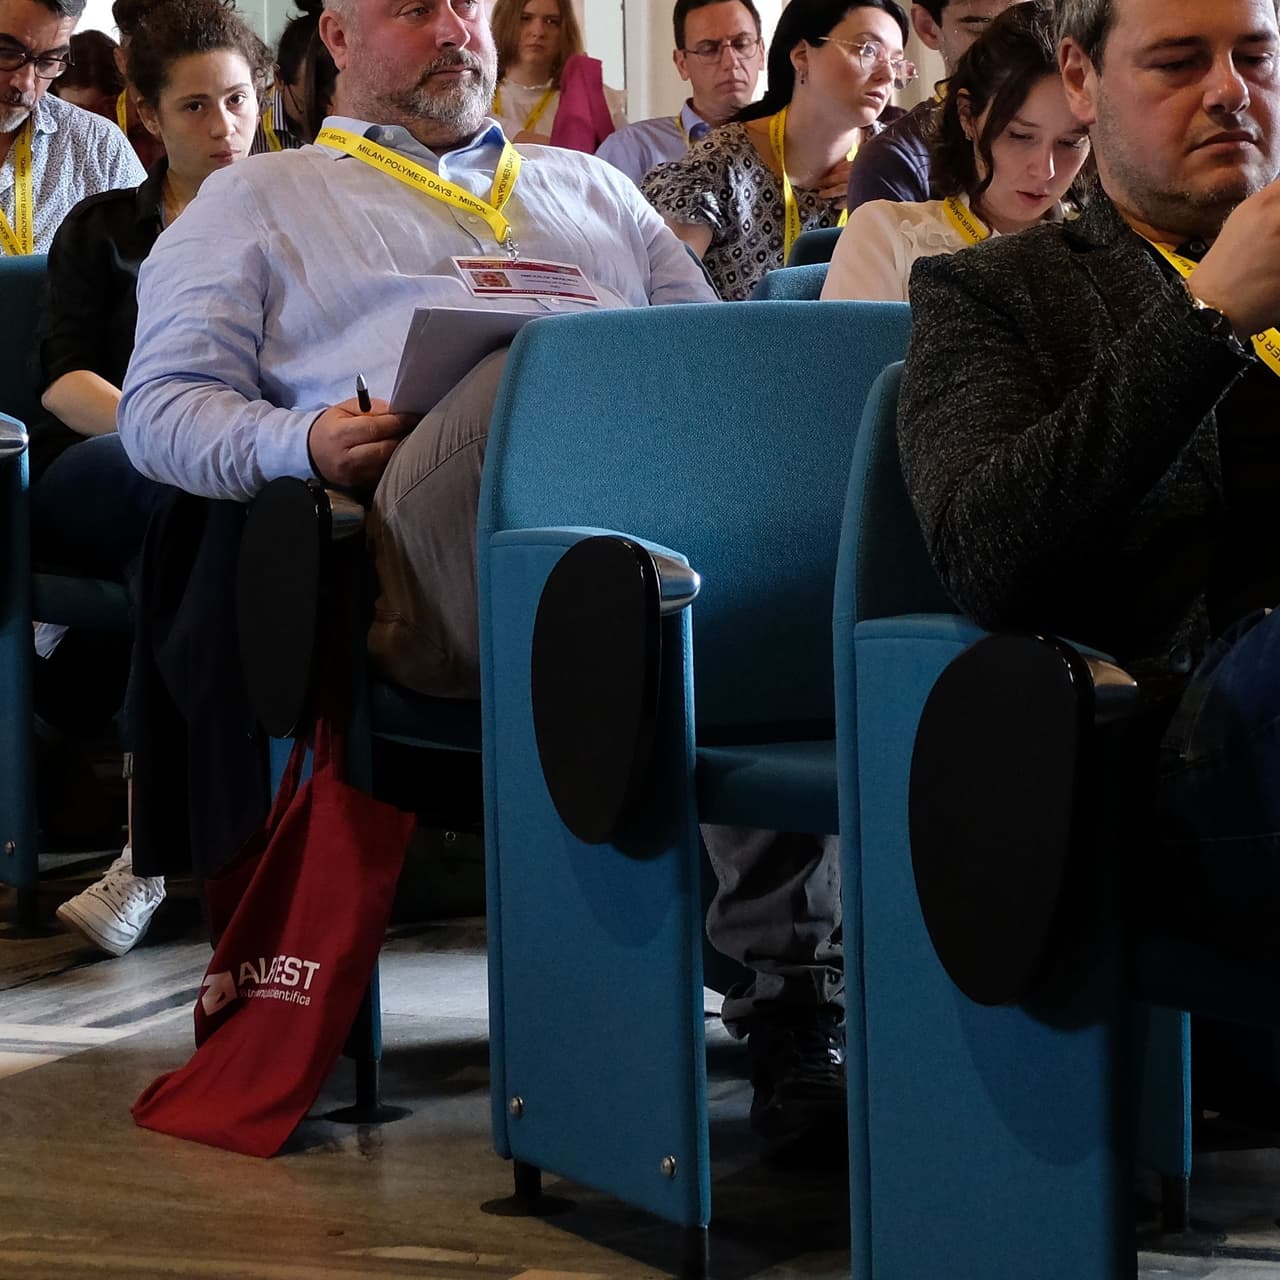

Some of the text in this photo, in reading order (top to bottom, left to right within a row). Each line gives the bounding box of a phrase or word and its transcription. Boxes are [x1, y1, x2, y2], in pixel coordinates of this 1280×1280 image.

[356, 143, 385, 163] MILAN
[384, 158, 427, 185] POLYMER
[427, 180, 453, 198] DAYS
[458, 195, 487, 215] MIPOL
